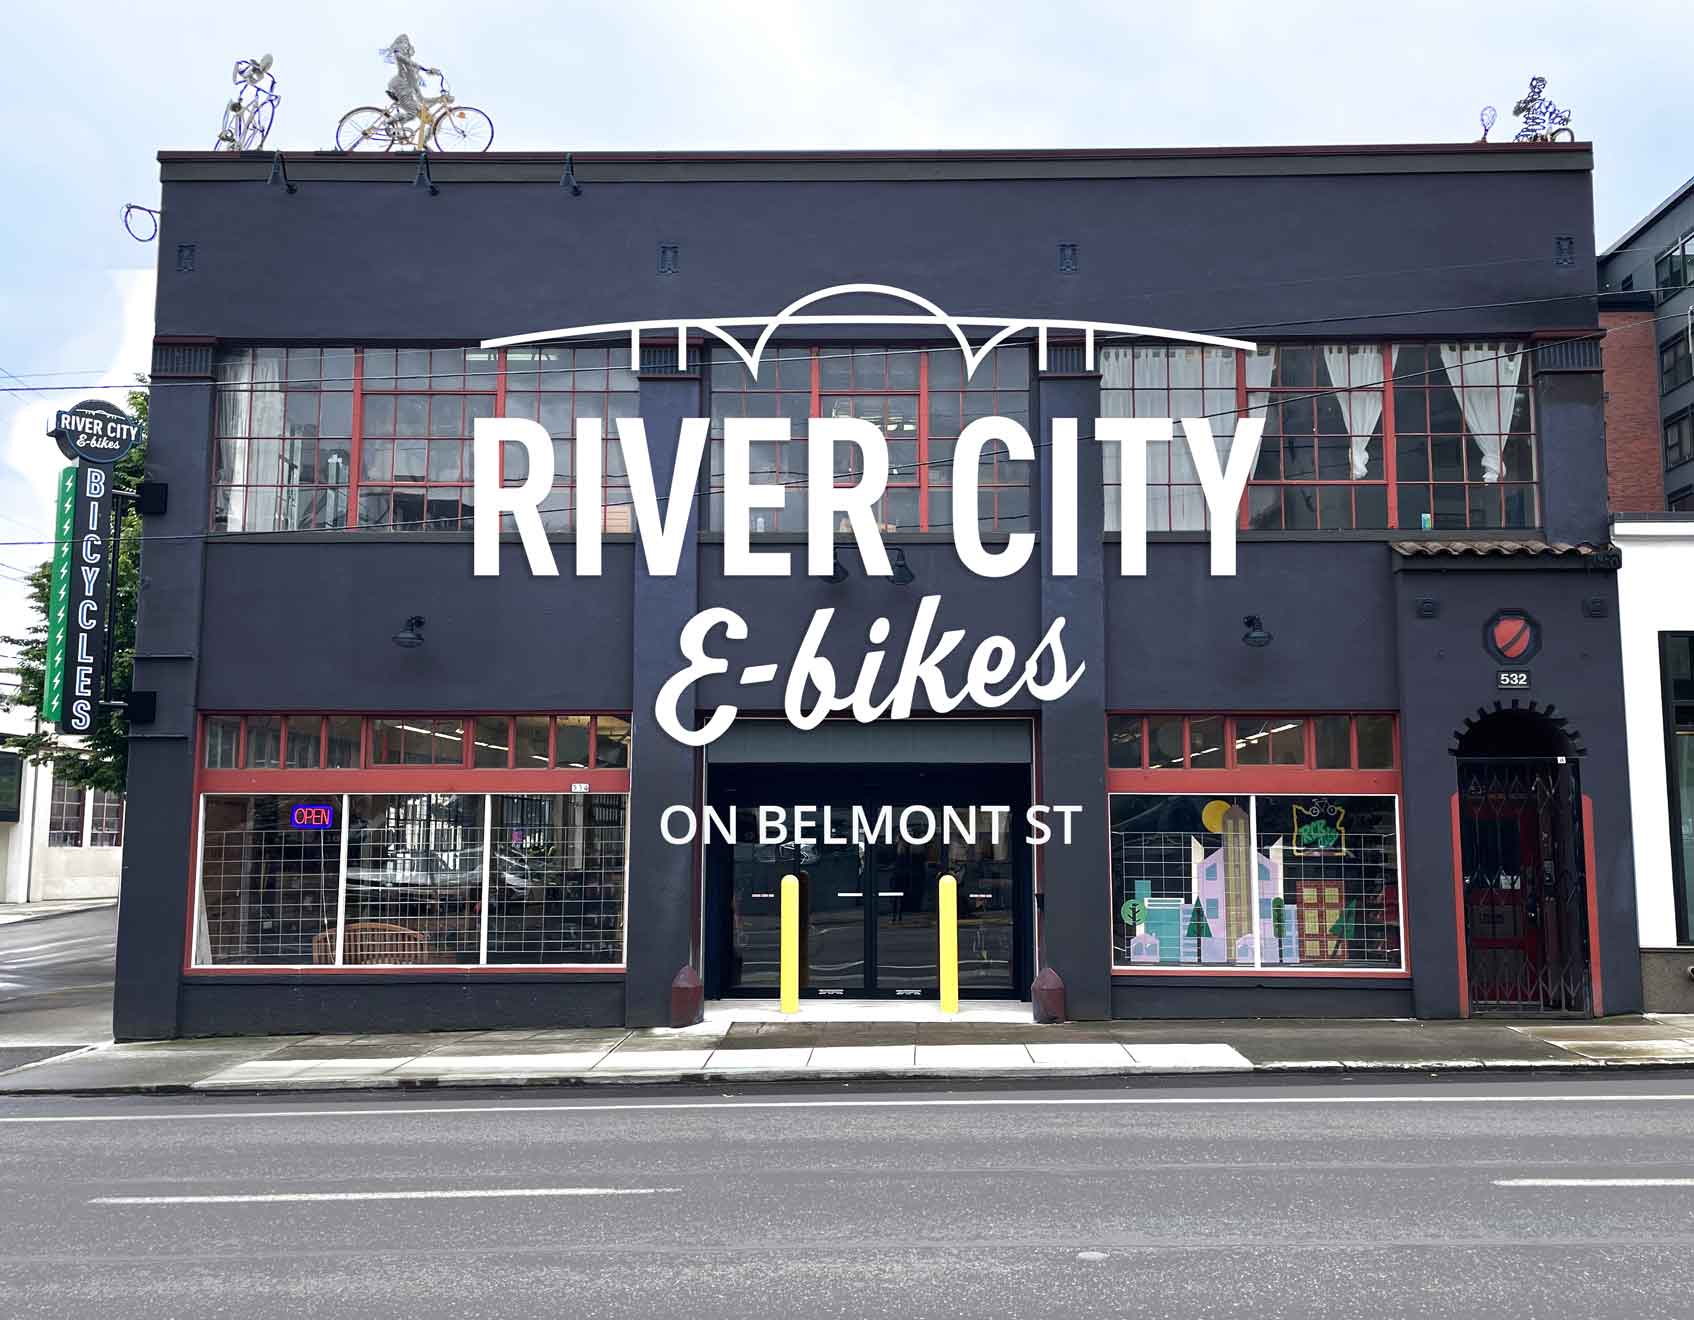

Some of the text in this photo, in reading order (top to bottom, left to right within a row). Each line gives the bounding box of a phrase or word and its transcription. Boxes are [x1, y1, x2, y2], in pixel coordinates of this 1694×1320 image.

[61, 413, 138, 441] RIVER CITY
[76, 433, 120, 450] E-bikes
[71, 467, 105, 731] BICYCLES
[1500, 673, 1527, 685] 532
[294, 808, 330, 825] OPEN
